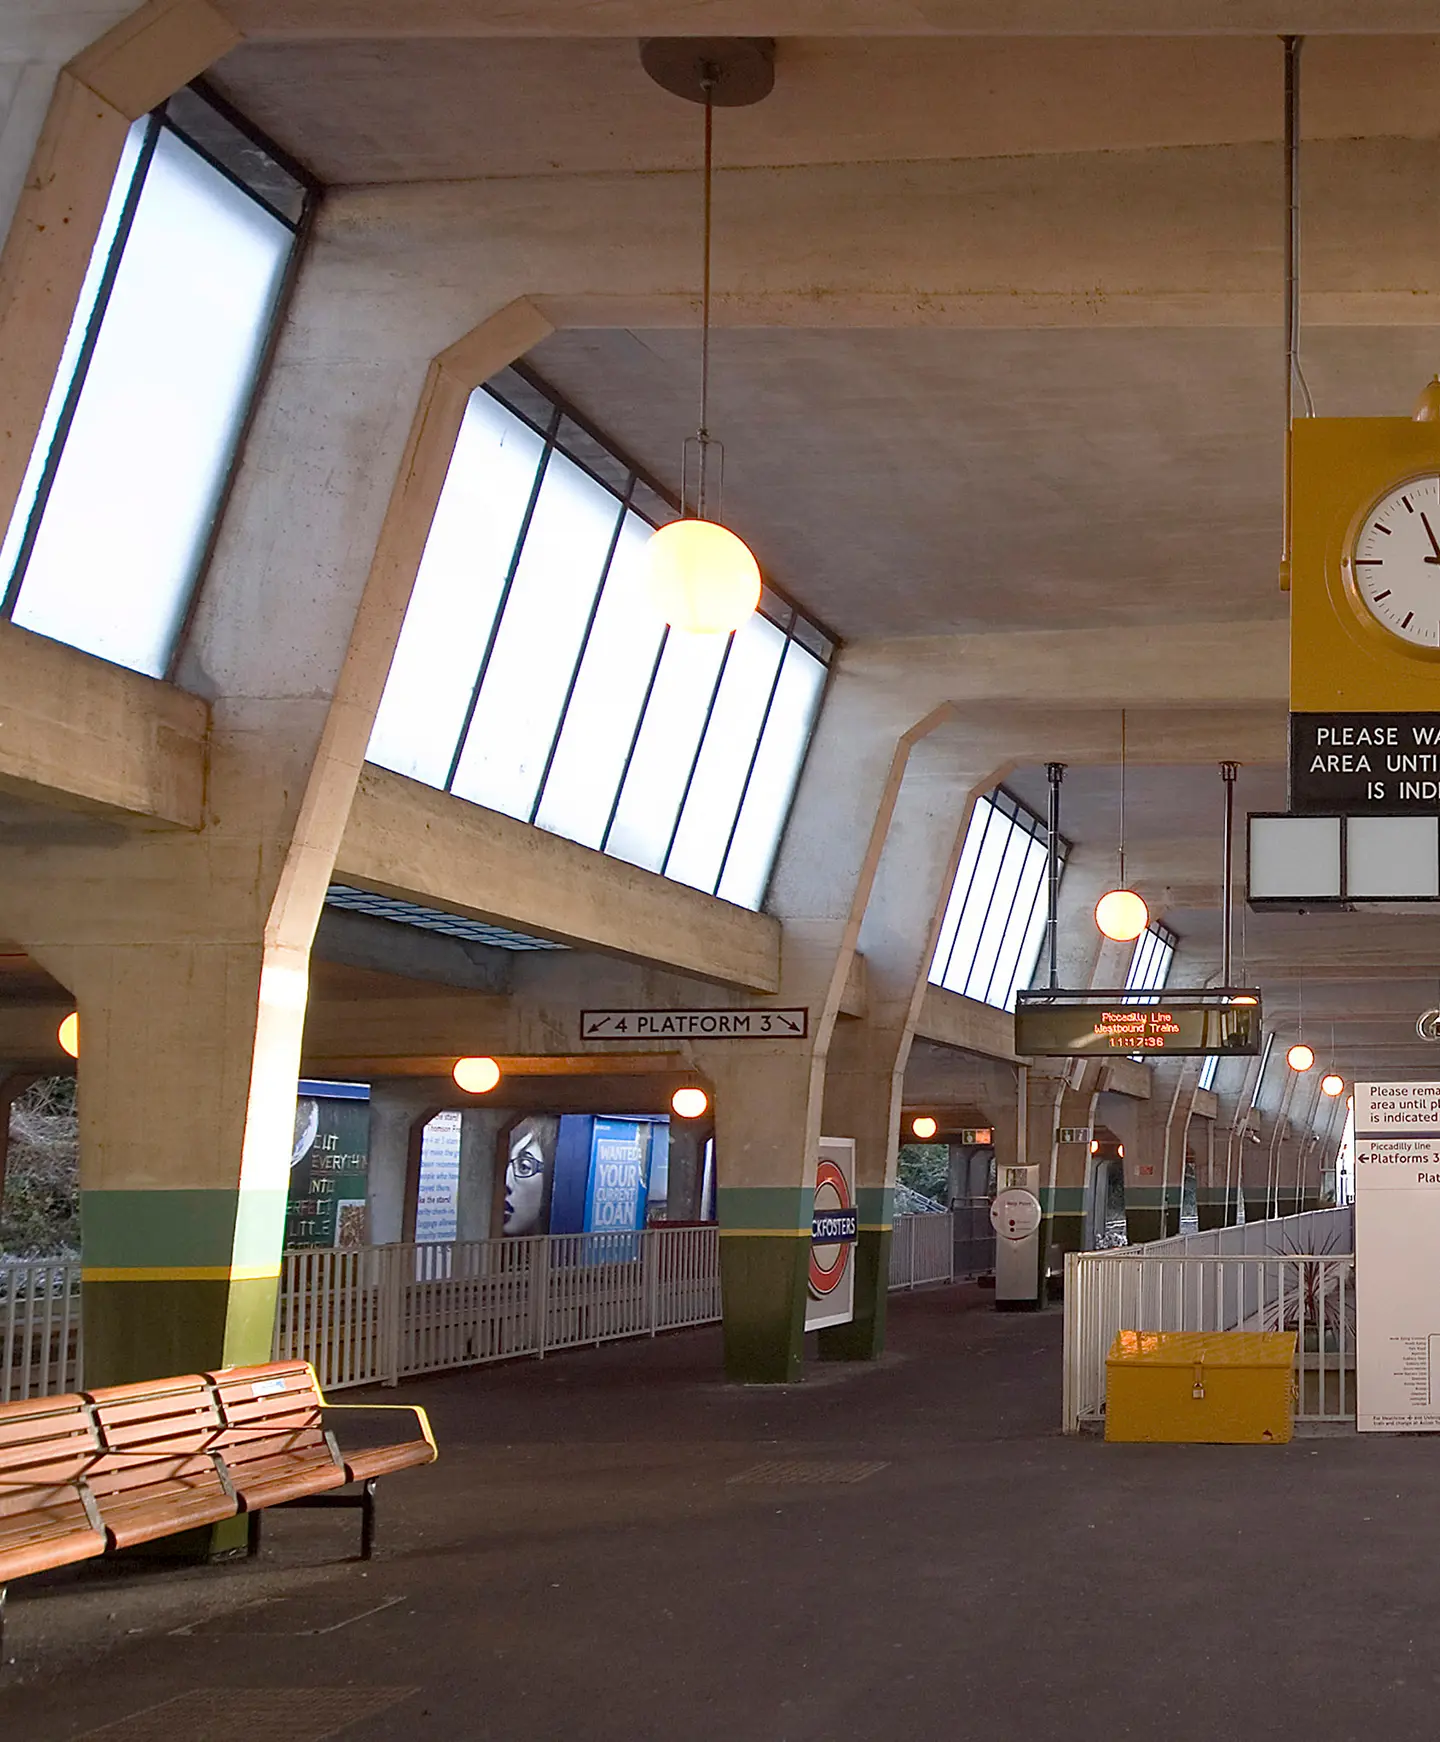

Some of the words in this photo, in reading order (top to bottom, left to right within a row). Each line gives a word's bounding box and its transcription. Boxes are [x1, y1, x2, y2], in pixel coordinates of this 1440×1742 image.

[1317, 727, 1398, 746] PLEASE
[1309, 755, 1372, 773] AREA
[1367, 781, 1385, 800] IS
[614, 1018, 628, 1033] 4
[637, 1015, 750, 1033] PLATFORM
[760, 1015, 772, 1032] 3
[1101, 1012, 1147, 1024] Piccadilly
[1151, 1012, 1172, 1023] Line
[1094, 1023, 1145, 1034] Westbound
[1149, 1023, 1180, 1034] Trains
[1109, 1037, 1164, 1047] 11:17:36
[1370, 1086, 1409, 1097] Please
[1370, 1101, 1395, 1110] area
[1399, 1099, 1426, 1109] until
[1370, 1113, 1380, 1123] is
[1383, 1112, 1438, 1123] indicated
[1370, 1142, 1412, 1151] Piccadilly
[1414, 1142, 1431, 1150] line
[1370, 1153, 1429, 1163] Platforms
[1432, 1153, 1440, 1163] 3
[599, 1164, 637, 1188] YOUR
[596, 1188, 636, 1201] CURRENT
[286, 1198, 332, 1215] ERFECT
[595, 1202, 634, 1226] LOAN
[811, 1217, 856, 1238] CKFOSTERS
